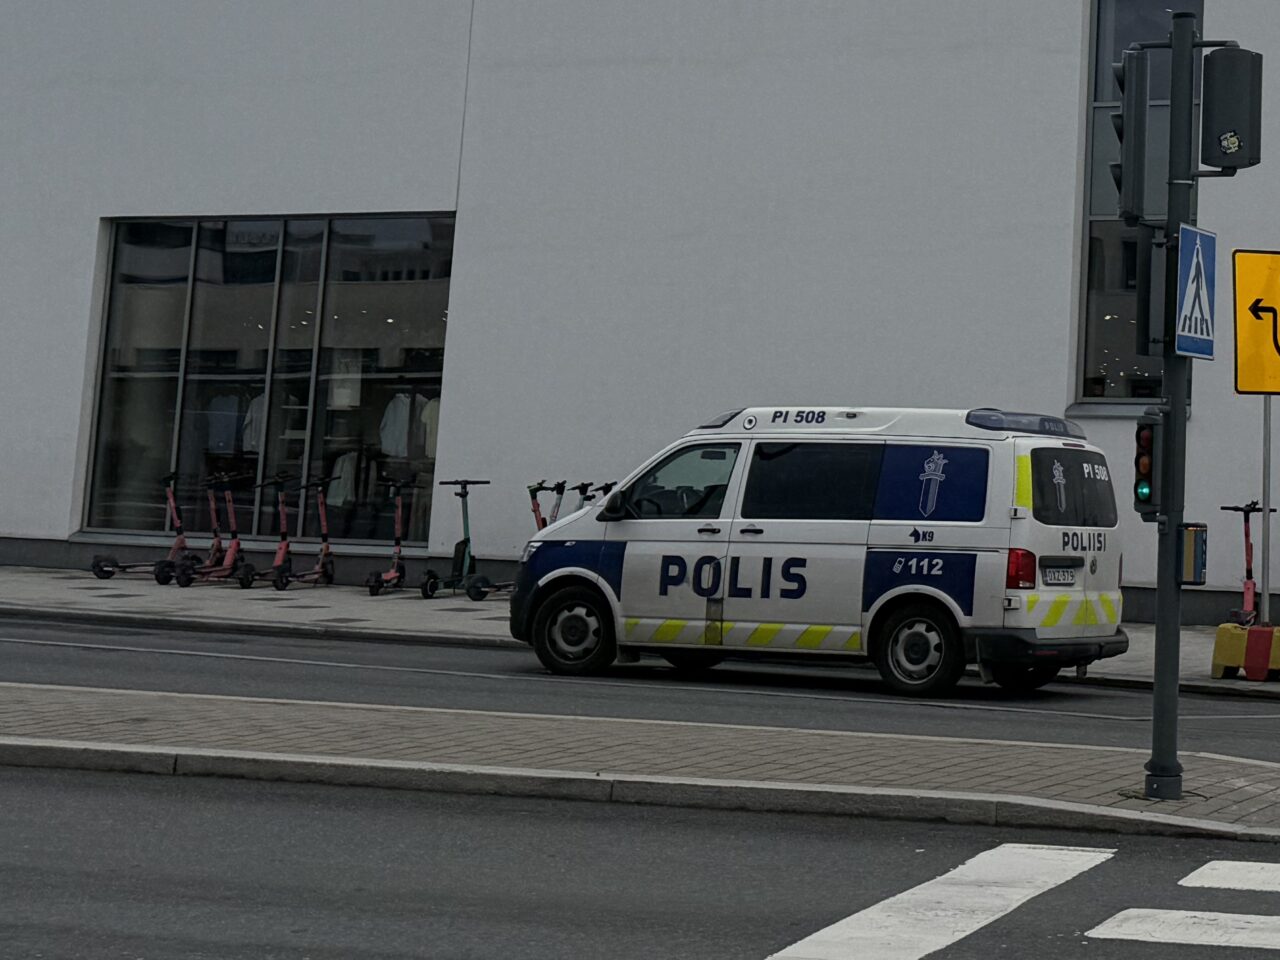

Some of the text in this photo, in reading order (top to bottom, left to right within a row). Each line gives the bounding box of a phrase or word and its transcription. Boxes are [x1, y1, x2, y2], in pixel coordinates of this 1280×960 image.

[771, 411, 826, 424] PI 508
[1083, 463, 1108, 481] PI 508
[921, 530, 934, 542] K9
[1062, 532, 1106, 552] POLIISI
[908, 558, 943, 576] 112
[658, 555, 808, 599] POLIS
